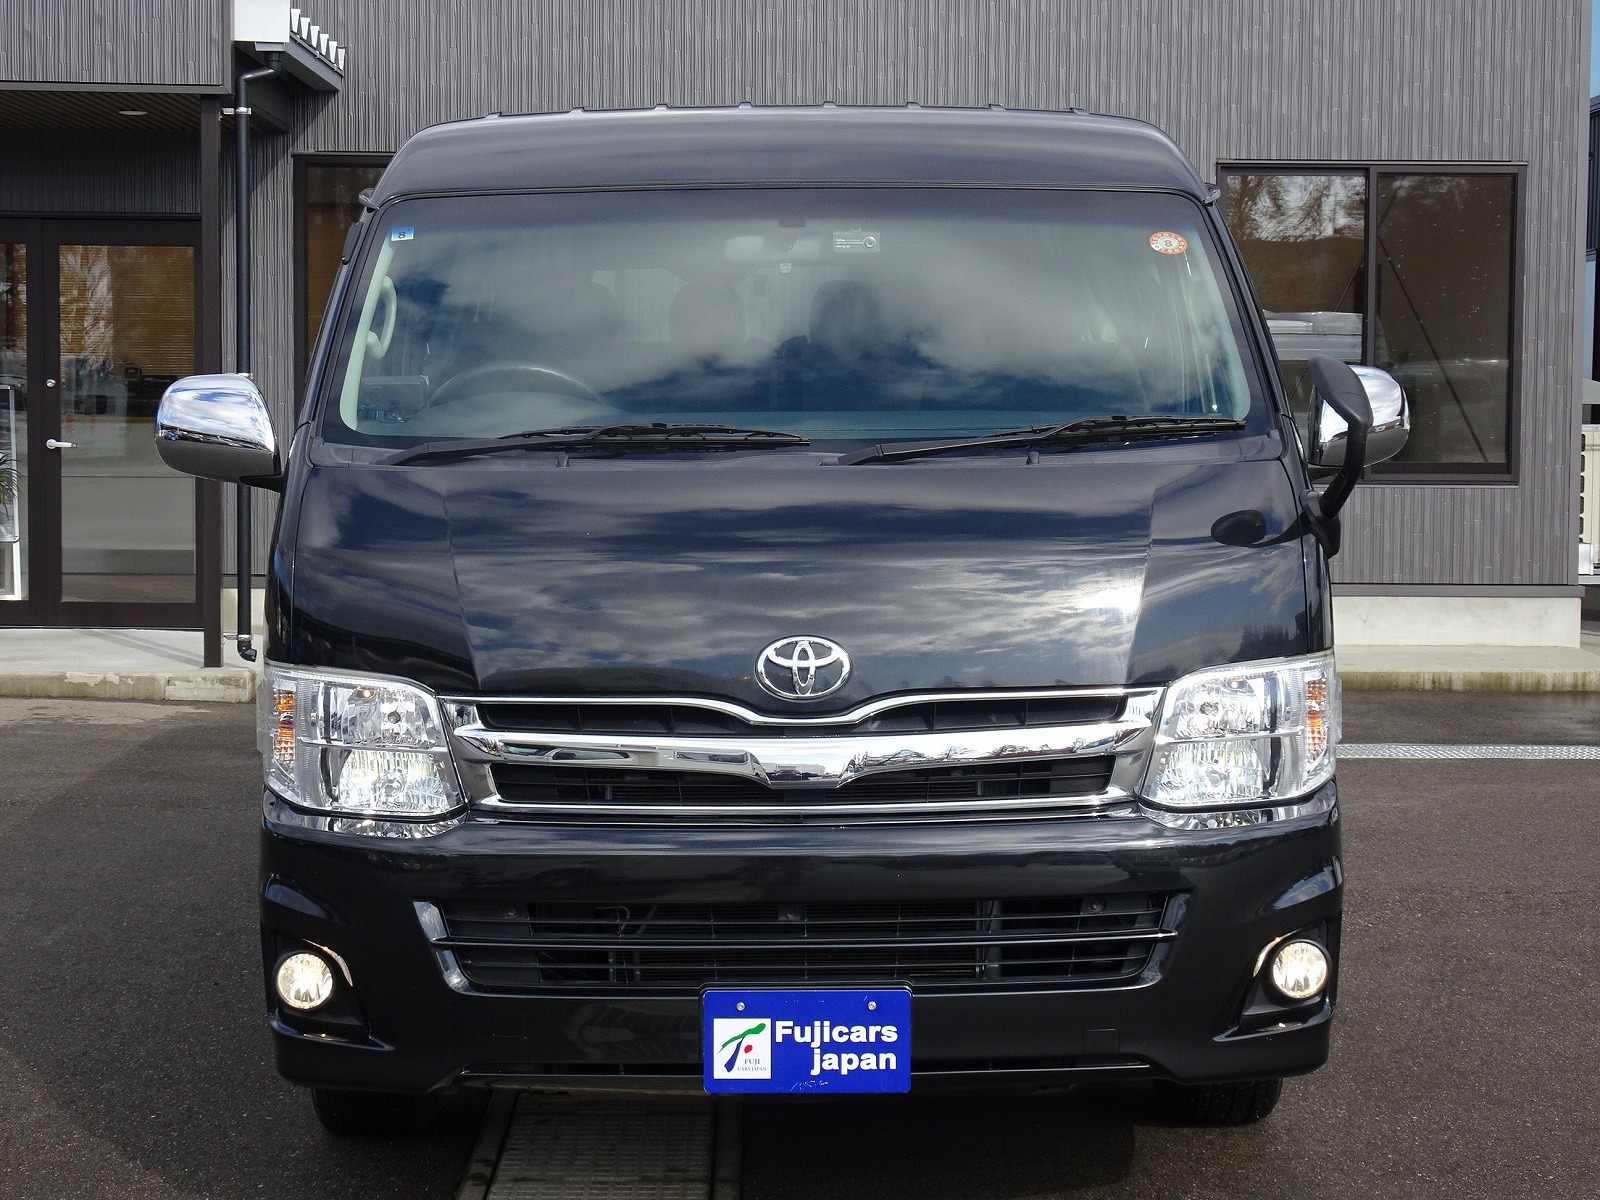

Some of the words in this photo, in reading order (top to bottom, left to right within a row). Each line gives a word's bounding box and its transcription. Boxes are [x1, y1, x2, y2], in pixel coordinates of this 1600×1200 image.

[1164, 239, 1173, 247] 8
[775, 1020, 898, 1048] Fujicars
[744, 1058, 760, 1066] FUJI
[810, 1048, 897, 1076] japan
